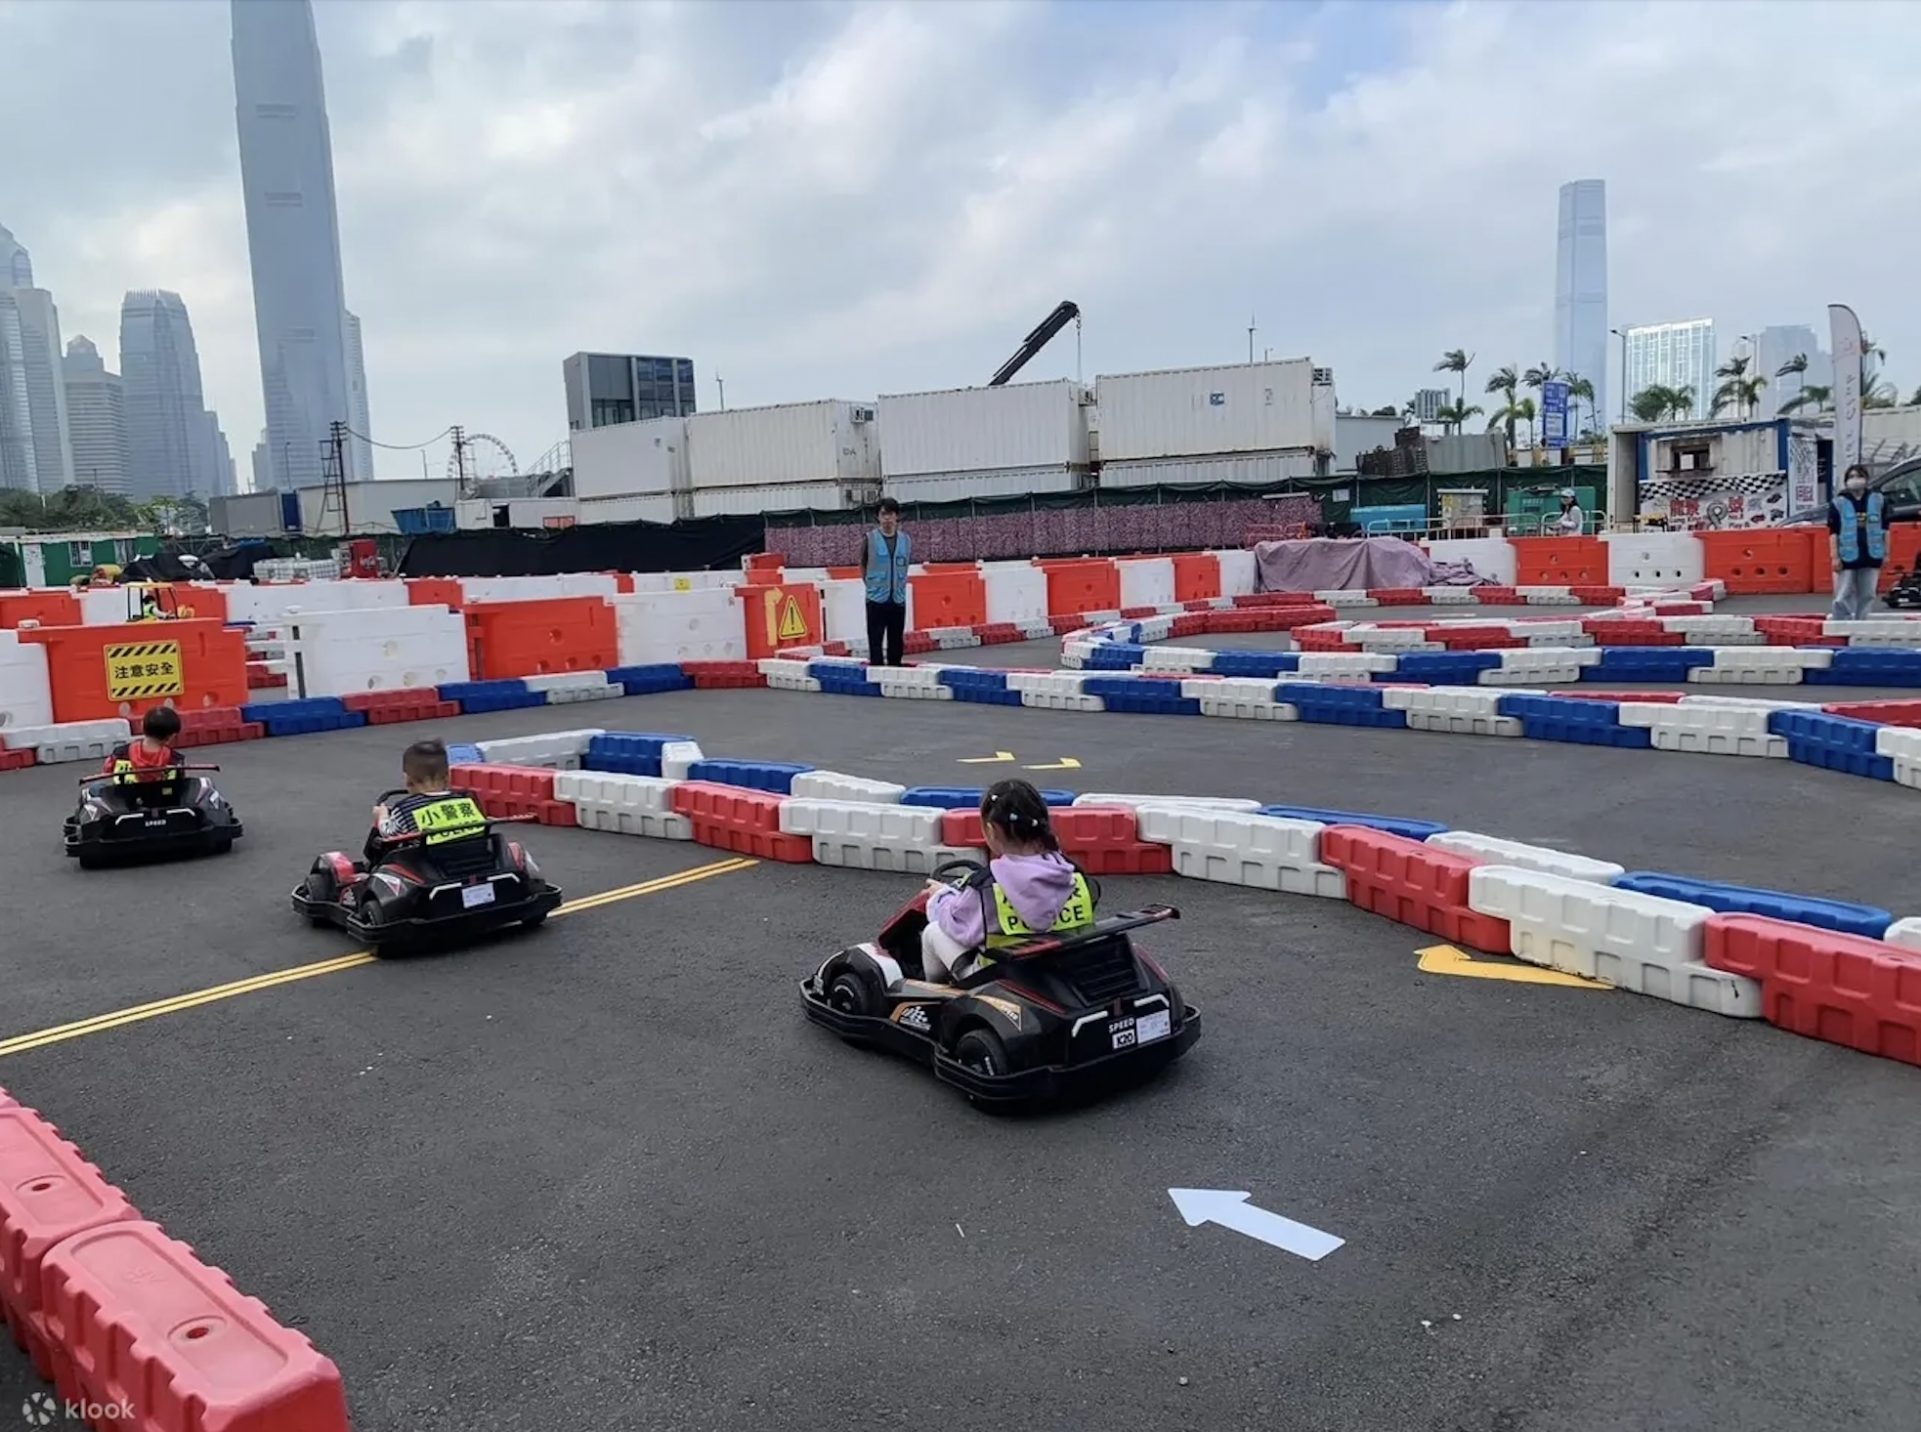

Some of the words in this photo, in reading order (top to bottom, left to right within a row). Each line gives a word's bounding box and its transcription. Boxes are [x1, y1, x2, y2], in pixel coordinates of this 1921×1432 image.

[115, 662, 174, 679] 注意安全
[421, 803, 475, 826] 小警察
[1008, 905, 1085, 930] PCE
[1109, 1017, 1135, 1034] SPEED
